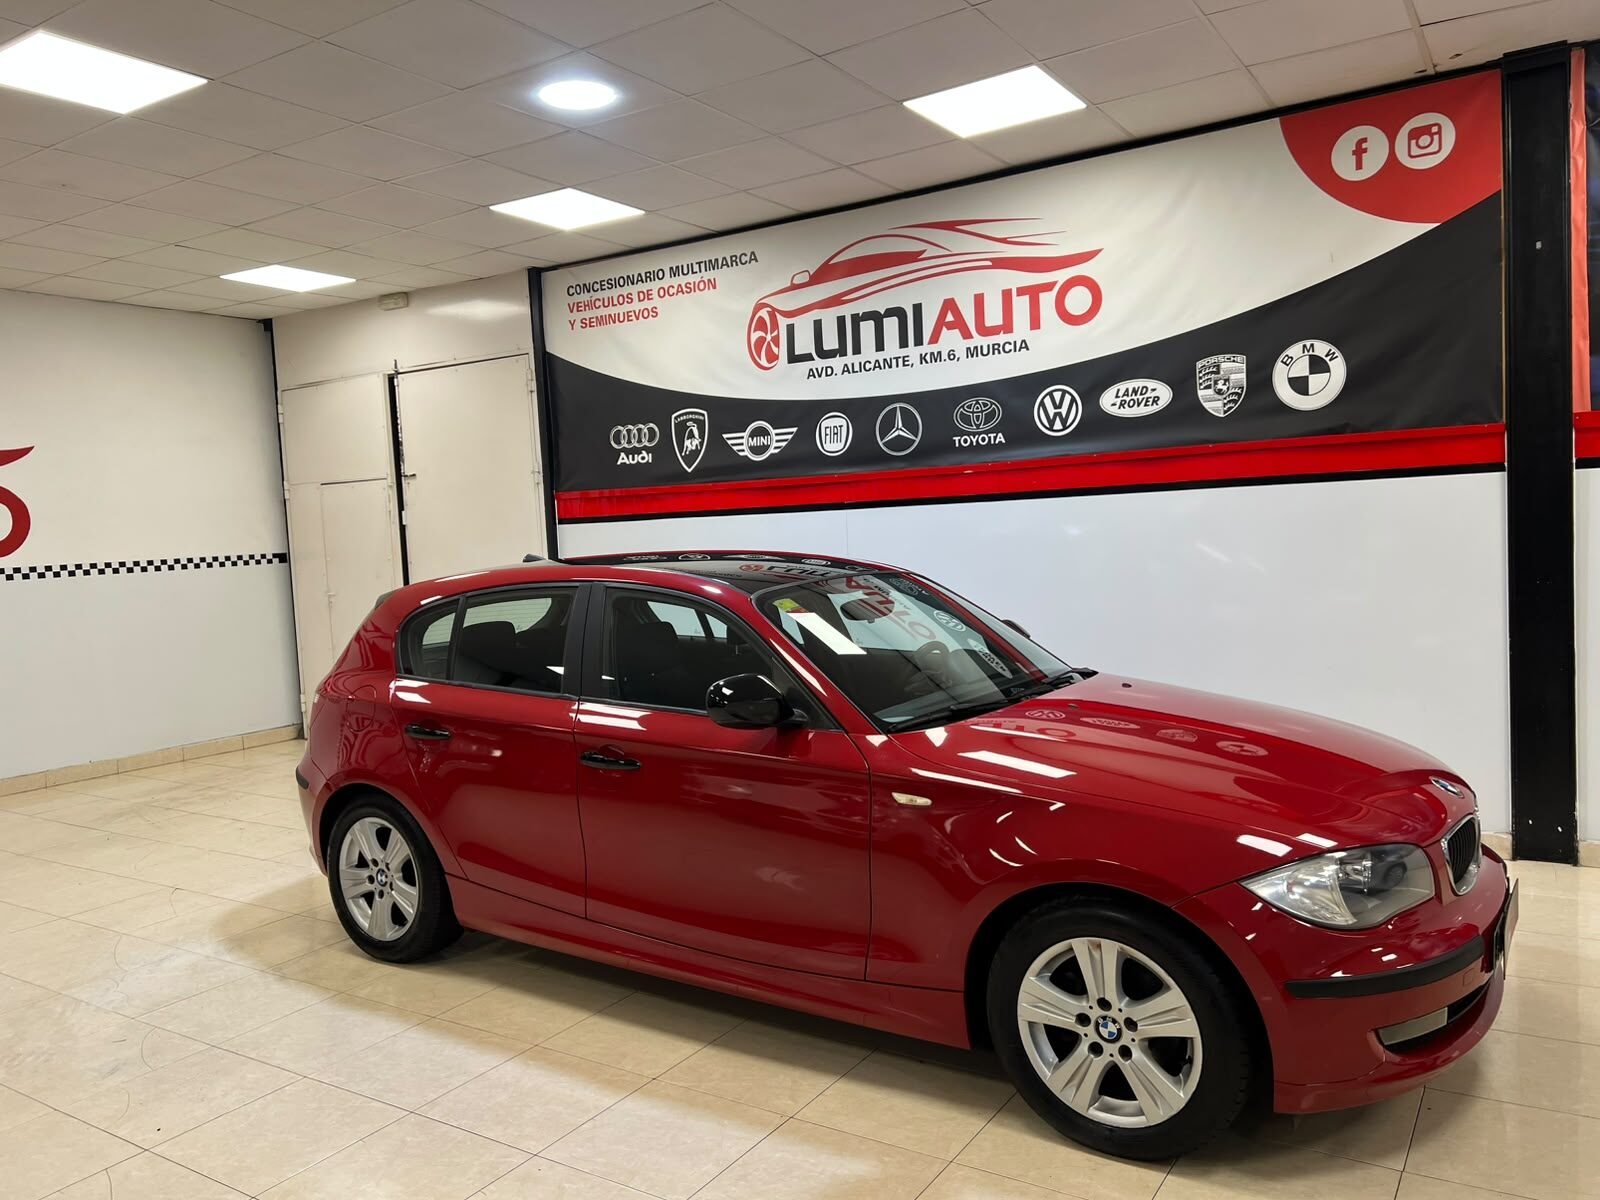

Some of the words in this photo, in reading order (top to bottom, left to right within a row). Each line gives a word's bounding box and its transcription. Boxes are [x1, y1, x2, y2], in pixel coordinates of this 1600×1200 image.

[566, 268, 665, 297] CONCESIONARIO
[669, 250, 759, 279] MULTIMARCA
[567, 292, 634, 314] VEHÍCULOS
[637, 288, 654, 303] DE
[657, 276, 718, 299] OCASIÓN
[568, 319, 577, 331] Y
[580, 306, 659, 329] SEMINUEVOS
[806, 364, 838, 380] AVD.
[841, 356, 914, 376] ALICANTE,
[919, 349, 960, 366] KM.6,
[965, 339, 1030, 359] MURCIA
[748, 435, 771, 448] MINI
[823, 424, 844, 445] FIAT
[952, 432, 1006, 447] TOYOTA
[616, 450, 652, 465] Audi
